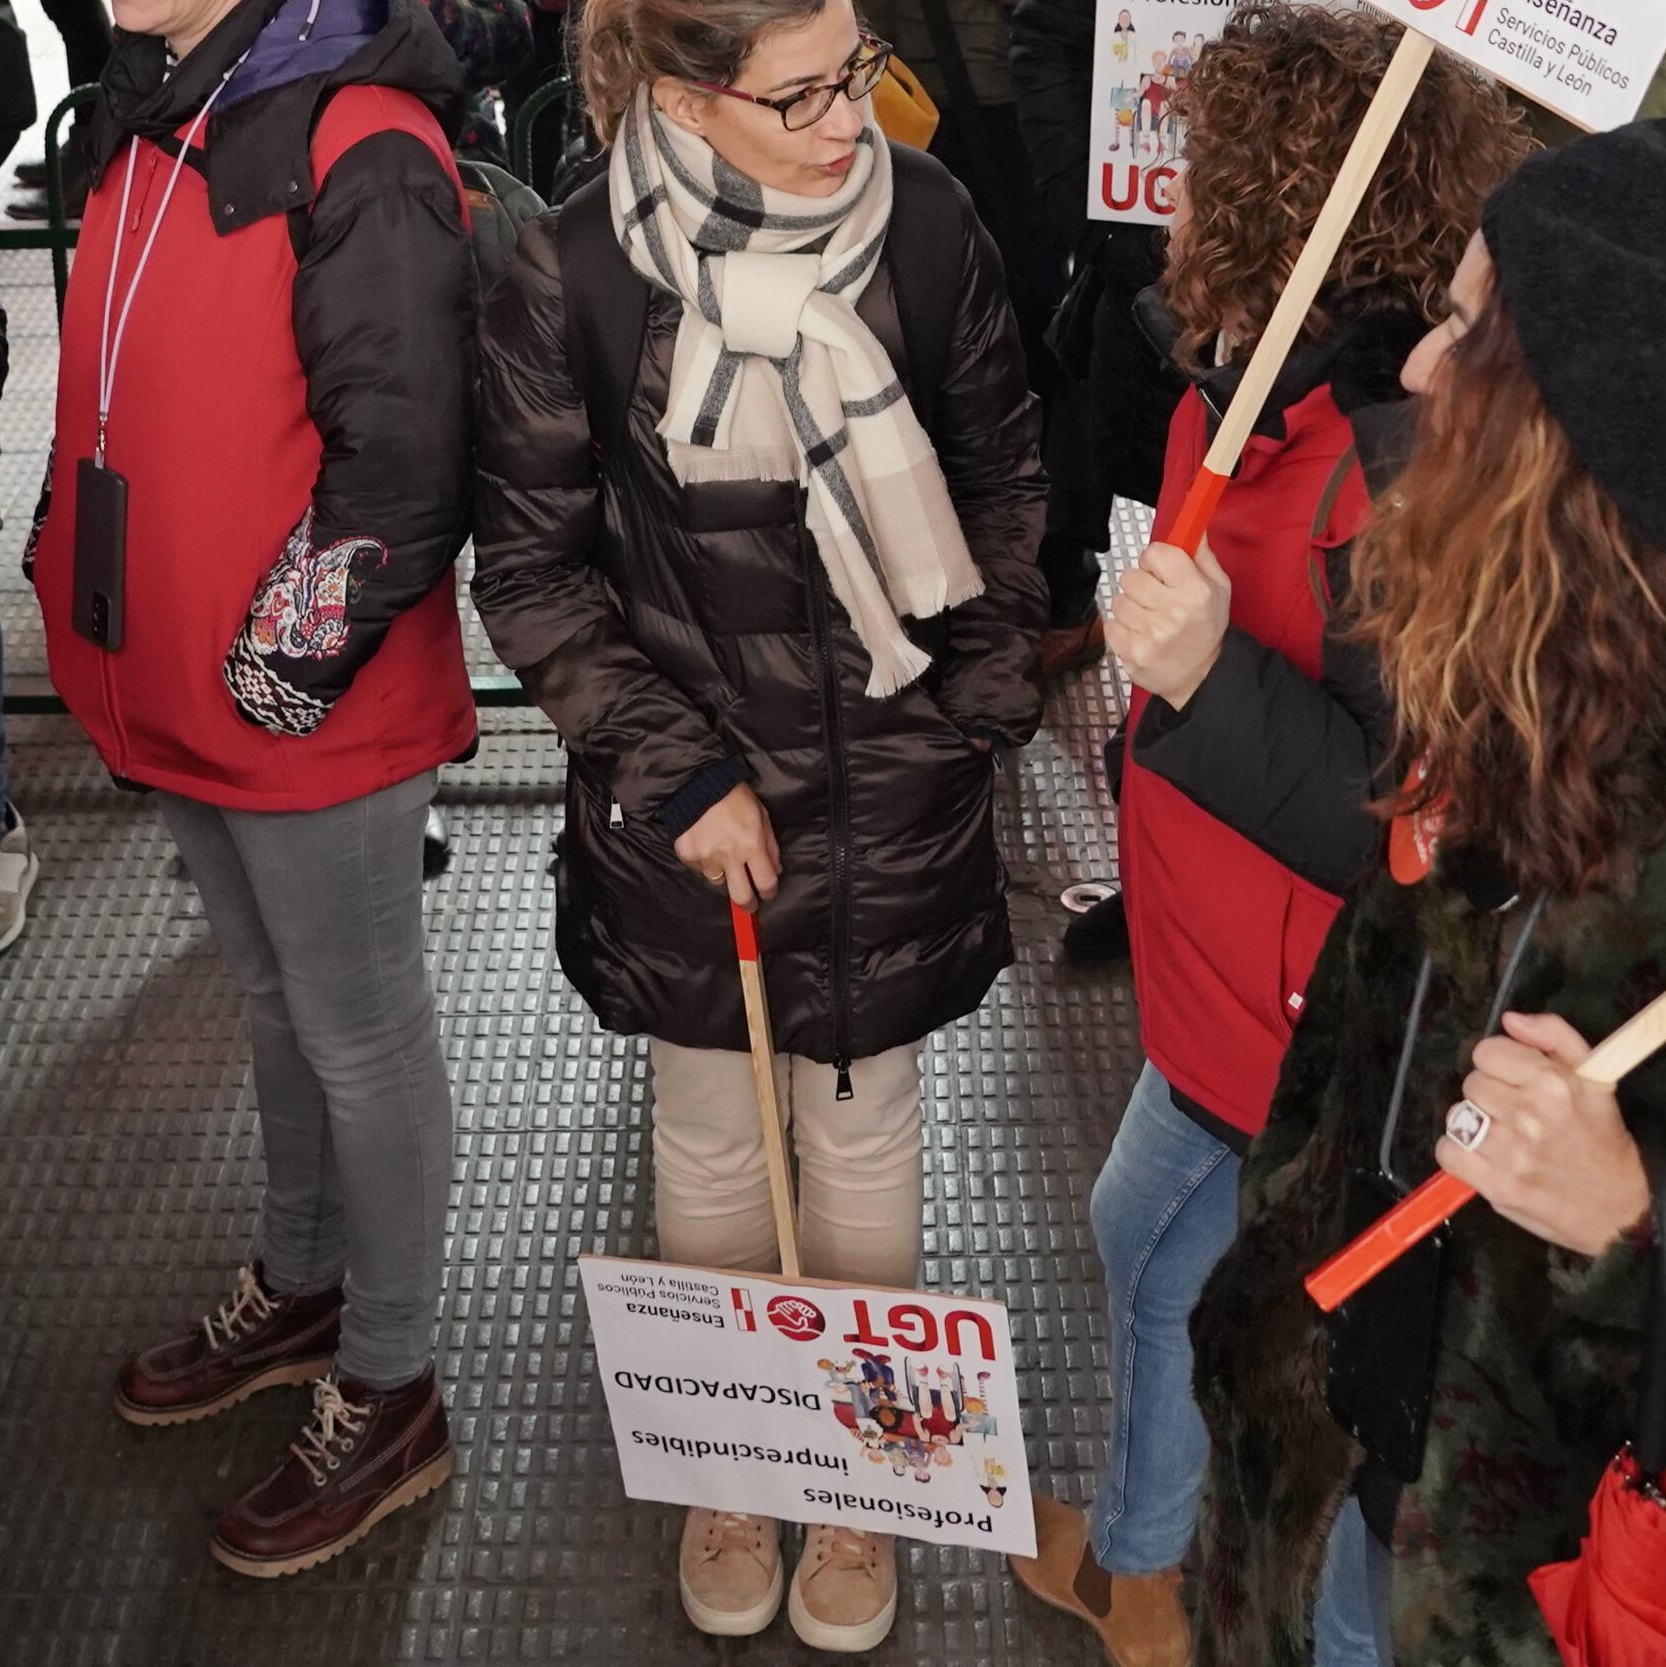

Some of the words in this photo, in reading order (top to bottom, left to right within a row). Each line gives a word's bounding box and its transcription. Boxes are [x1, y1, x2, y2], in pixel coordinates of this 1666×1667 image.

[1487, 28, 1542, 75] Castilla
[1542, 60, 1558, 84] y
[1554, 63, 1594, 98] León
[1495, 6, 1566, 60] Servicios
[1567, 40, 1630, 88] Públicos
[597, 1282, 656, 1299] Públicos
[620, 1274, 654, 1287] León
[658, 1275, 666, 1286] y
[669, 1279, 719, 1296] Castilla
[626, 1302, 725, 1328] Enseñanza
[659, 1290, 721, 1309] Servicios
[843, 1299, 997, 1360] UGT
[615, 1370, 821, 1411] DISCAPACIDAD
[632, 1429, 850, 1476] imprescindibles
[804, 1487, 993, 1533] Profesionales
